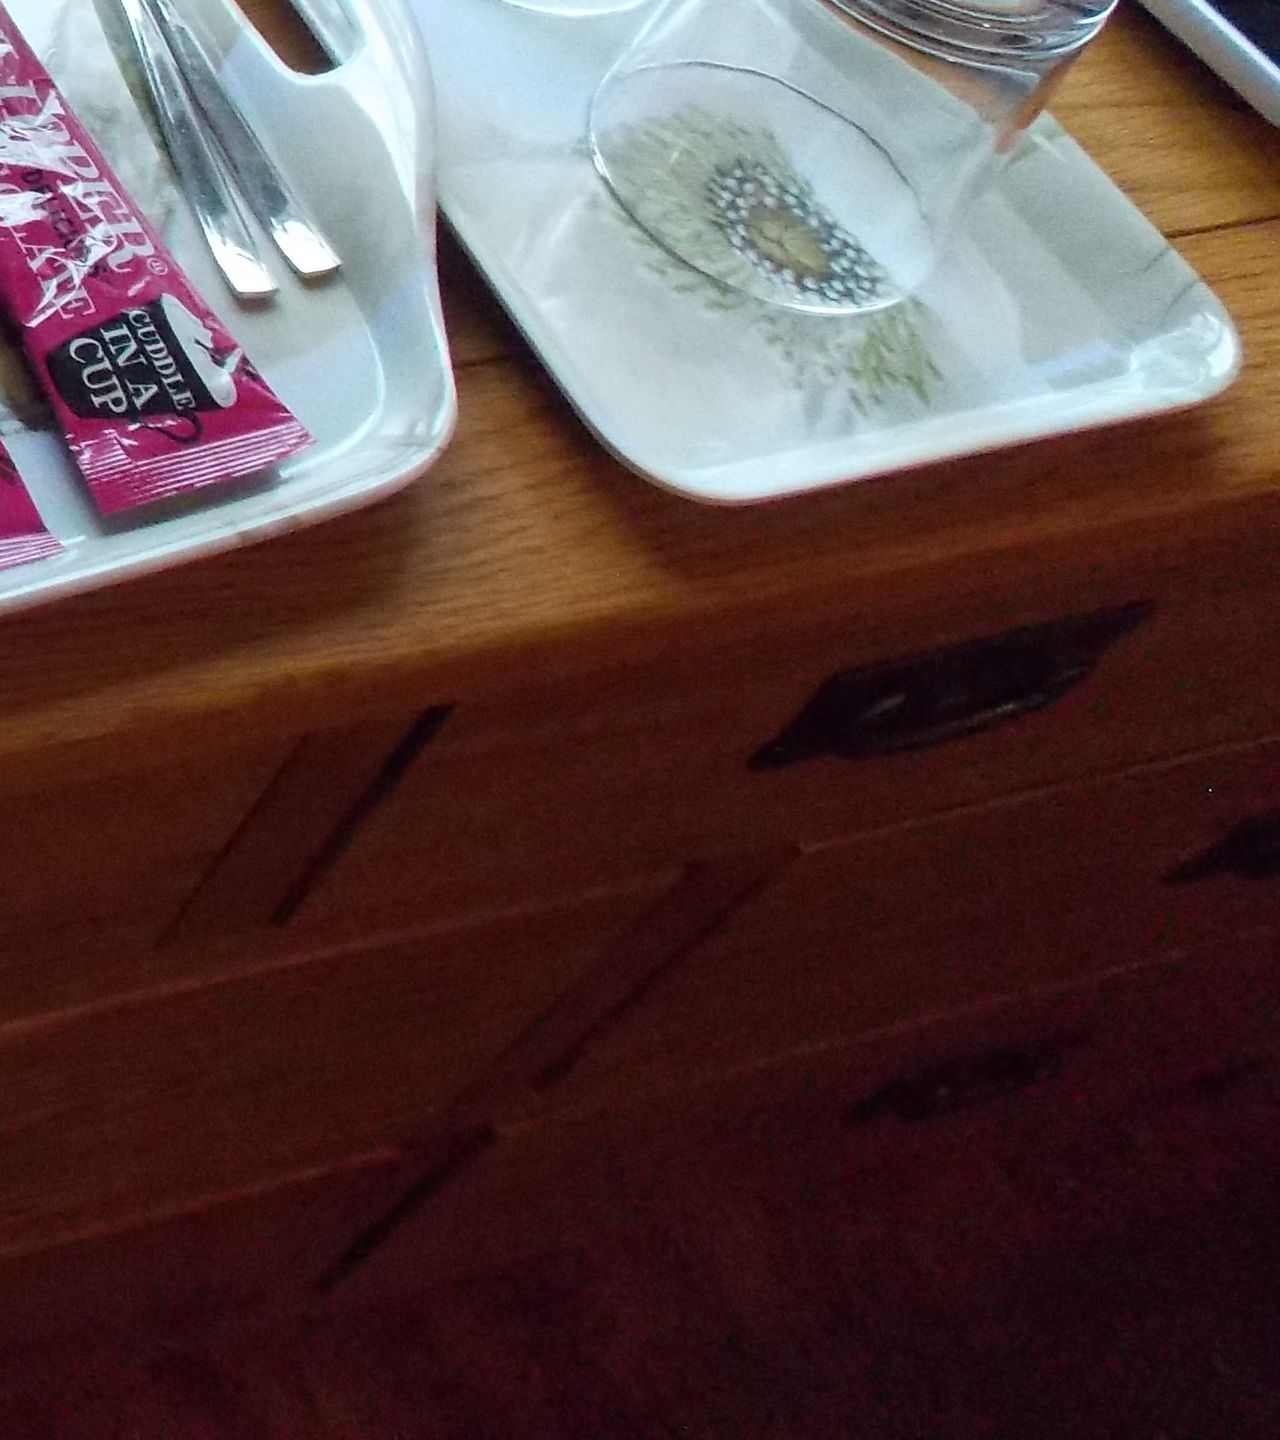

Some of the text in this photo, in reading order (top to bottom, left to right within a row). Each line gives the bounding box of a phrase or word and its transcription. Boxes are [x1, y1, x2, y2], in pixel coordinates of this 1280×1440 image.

[68, 337, 129, 414] CUP
[99, 323, 160, 411] IN A
[128, 309, 196, 411] CUDDLE
